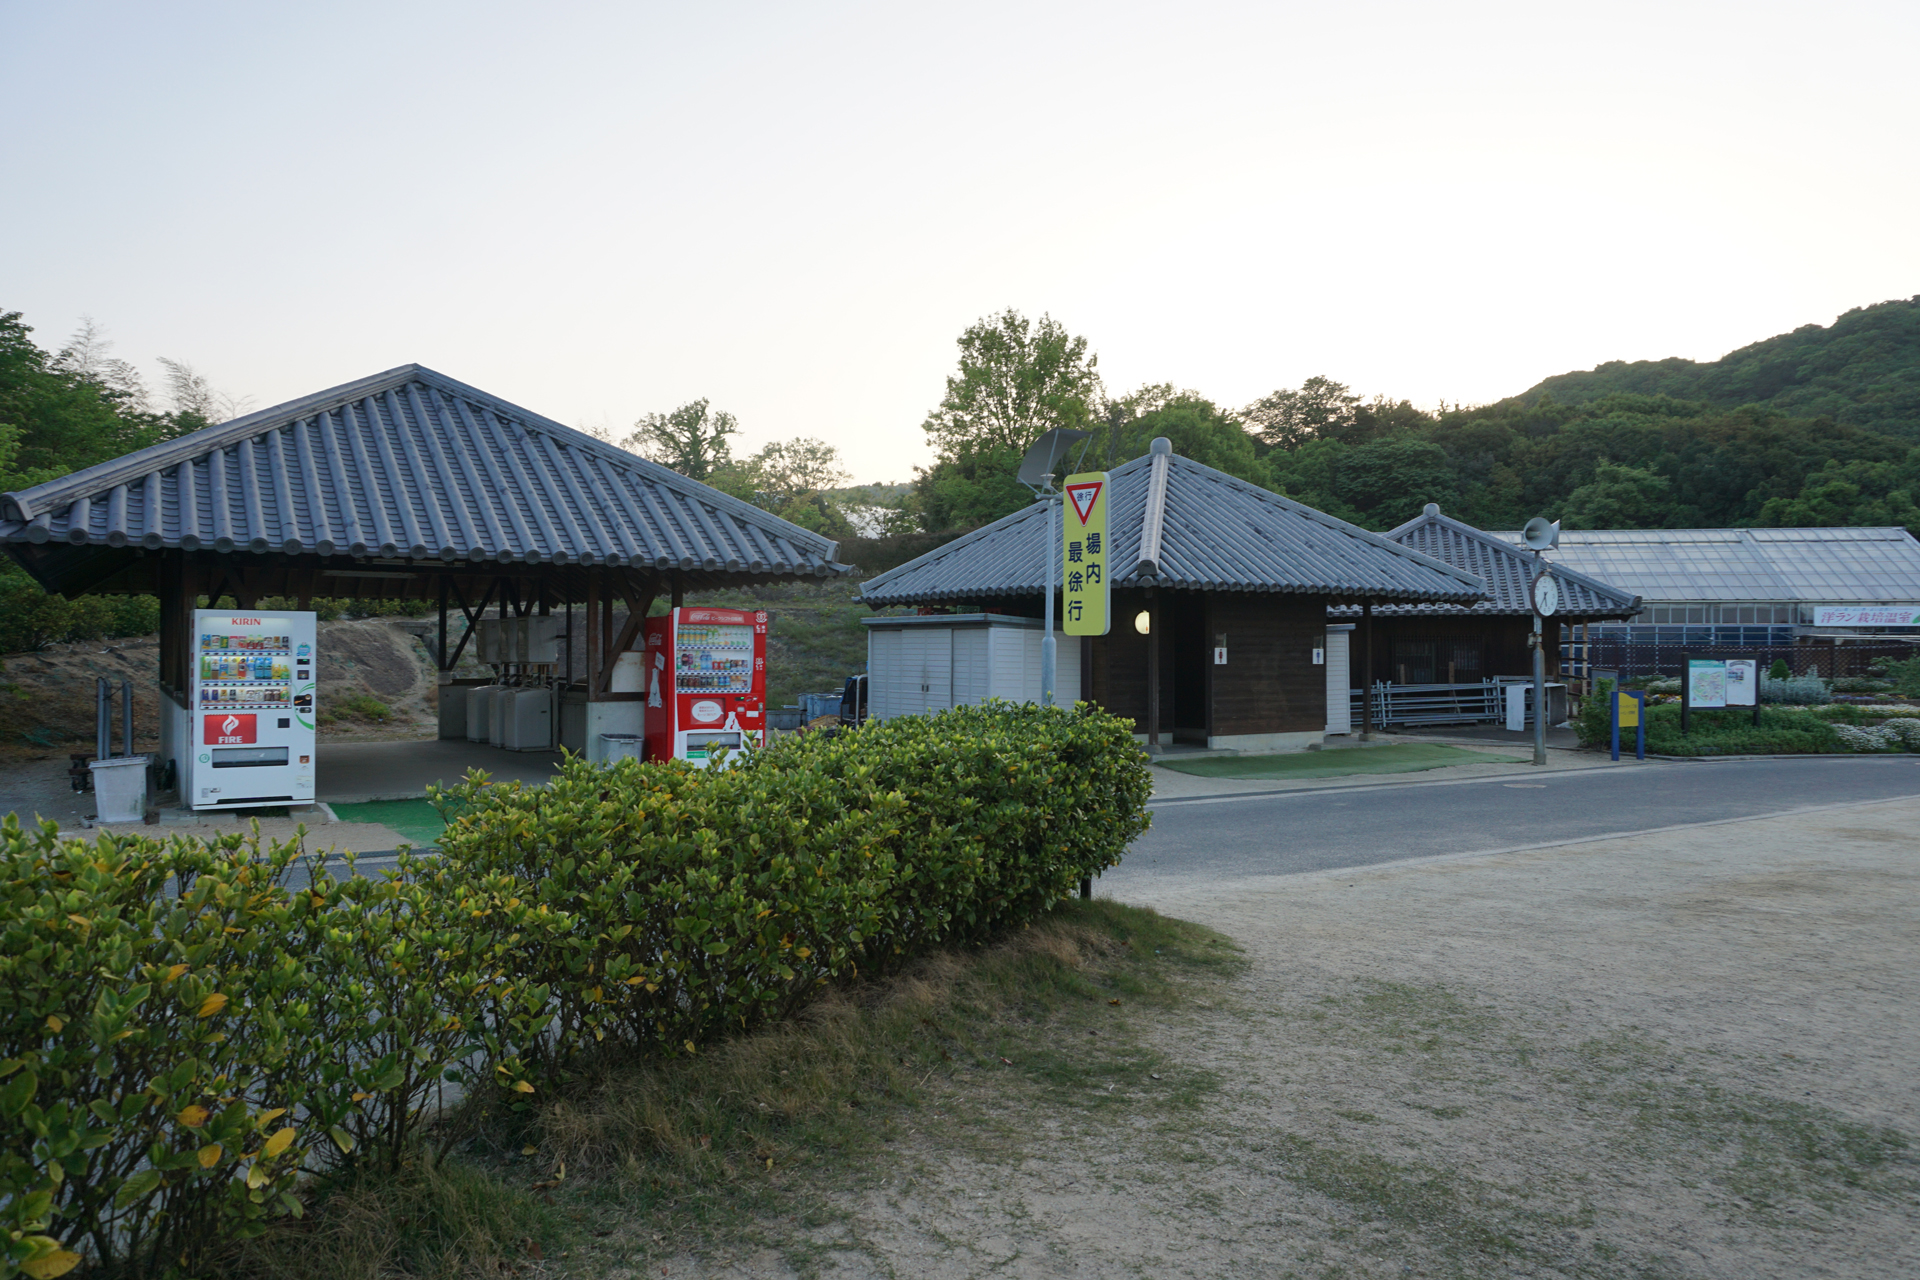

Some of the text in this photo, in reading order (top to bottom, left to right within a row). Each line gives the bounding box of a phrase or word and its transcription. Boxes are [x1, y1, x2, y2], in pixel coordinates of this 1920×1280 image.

[1076, 491, 1093, 503] 徐行
[1086, 532, 1101, 585] 場内
[1068, 541, 1083, 622] 最徐行
[231, 617, 261, 626] KIRIN
[1820, 611, 1913, 624] 洋ラン栽培温室
[218, 735, 243, 744] FIRE
